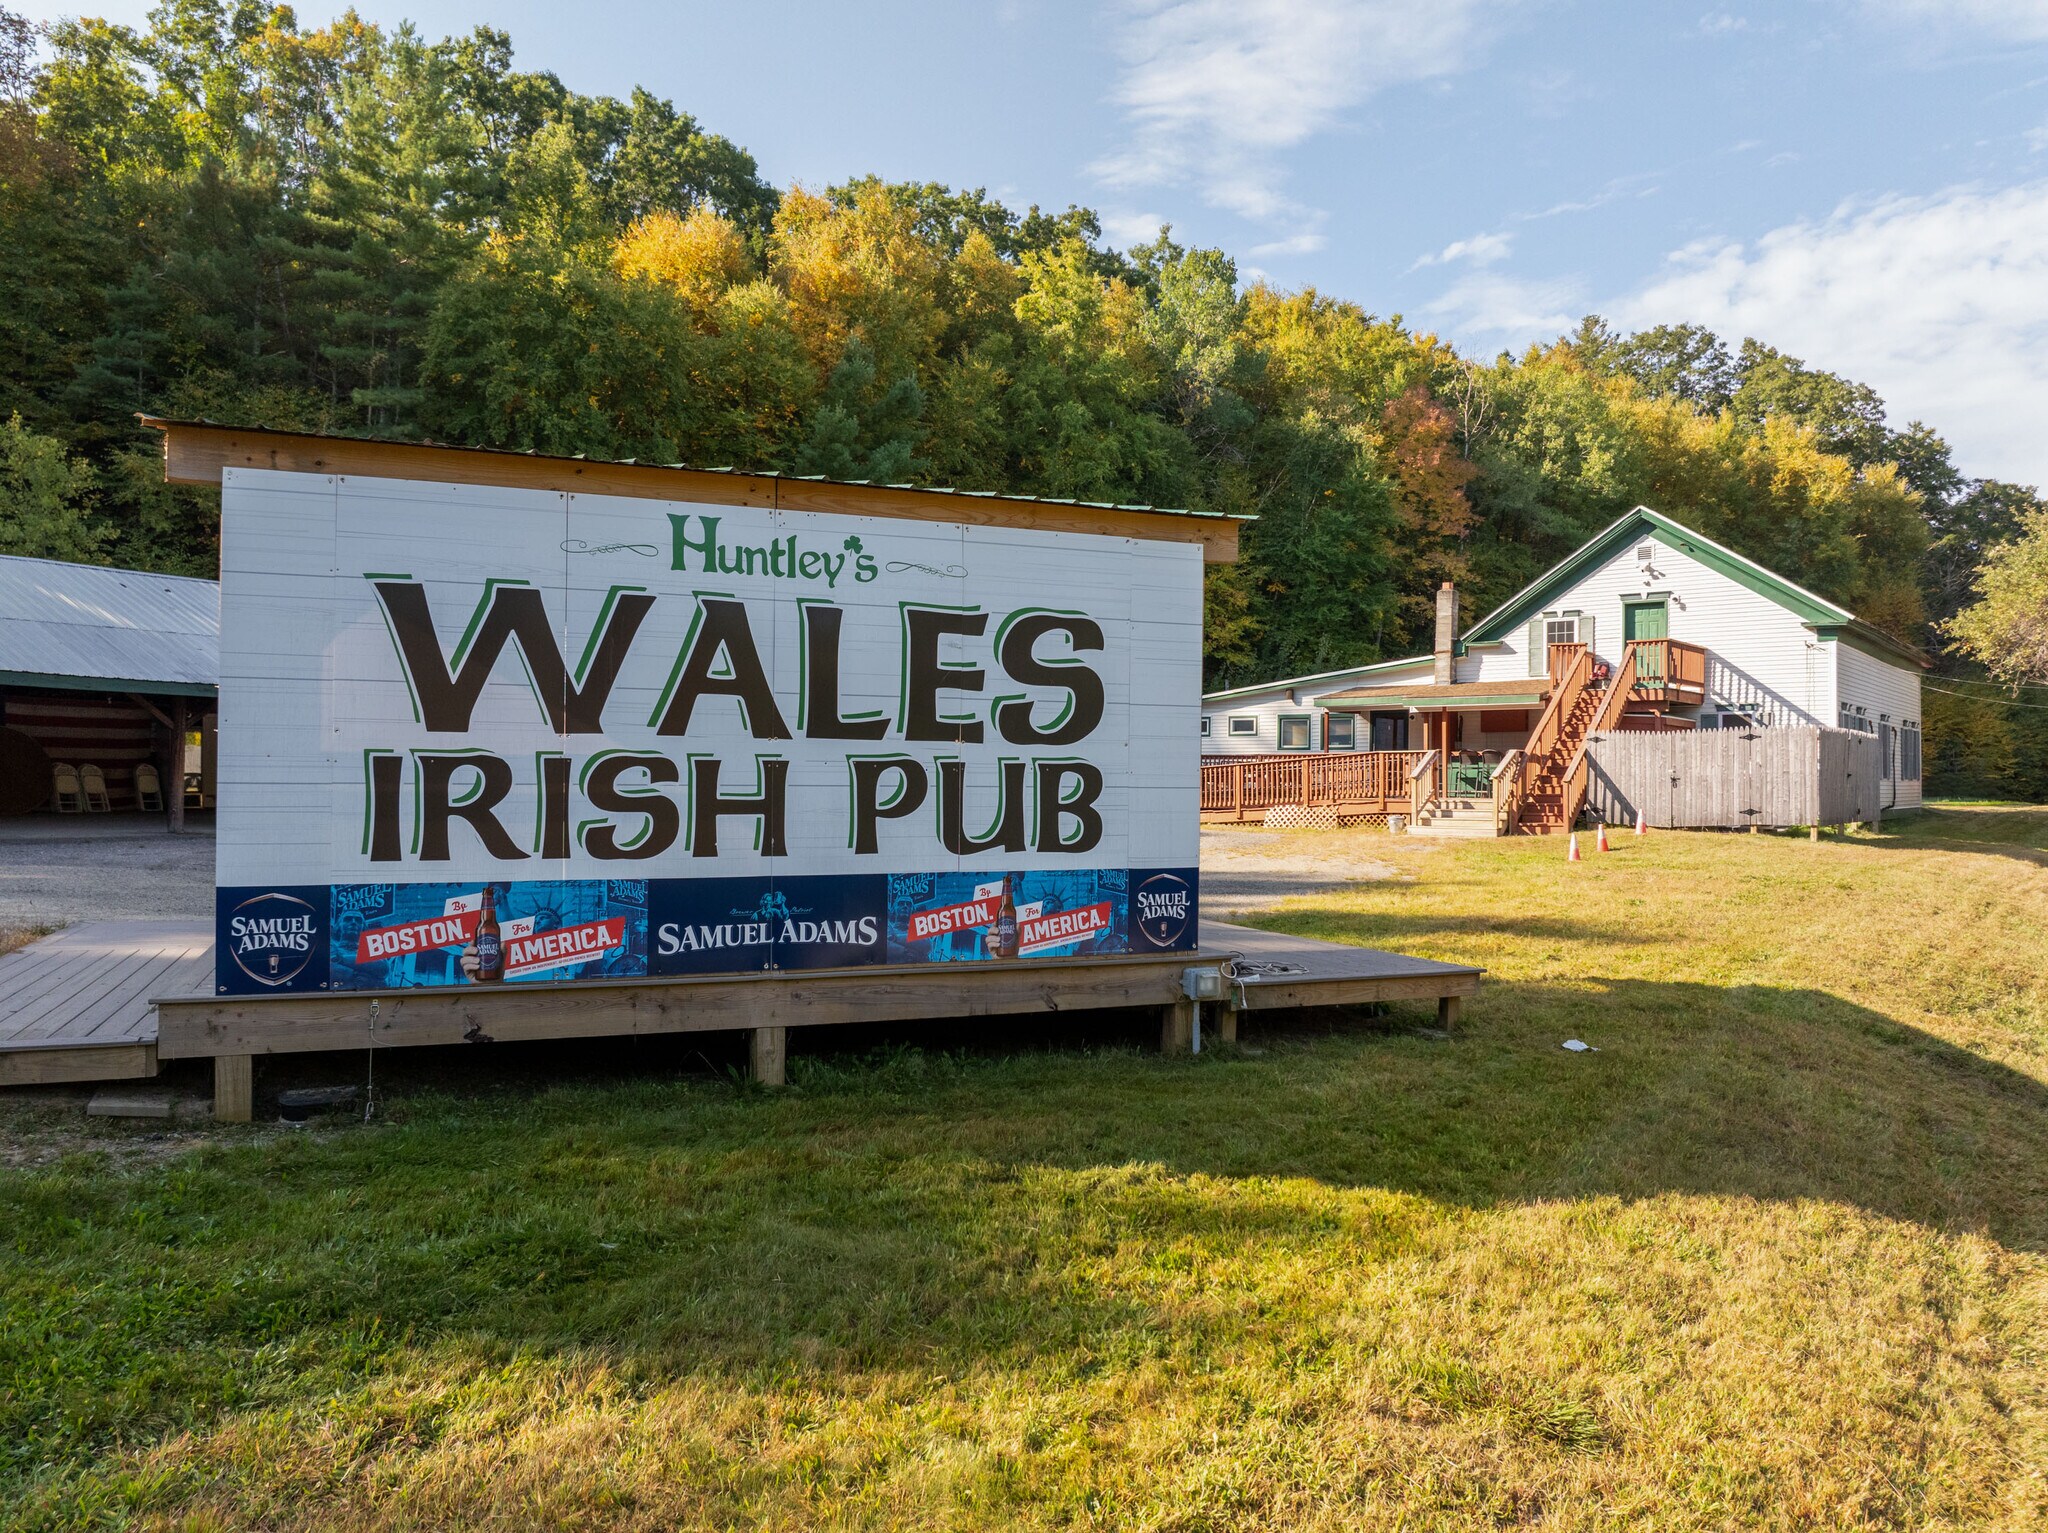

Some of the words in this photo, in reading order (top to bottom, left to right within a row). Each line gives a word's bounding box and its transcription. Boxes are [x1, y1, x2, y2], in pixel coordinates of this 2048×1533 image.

[363, 573, 1104, 745] WALES
[362, 748, 788, 861] IRISH
[845, 753, 1103, 856] PUB
[980, 888, 991, 898] By
[1137, 890, 1190, 908] SAMUEL
[452, 901, 468, 912] By
[1025, 907, 1040, 918] For
[1142, 905, 1186, 922] ADAMS
[231, 915, 317, 937] SAMUEL
[512, 924, 531, 935] For
[914, 903, 994, 936] BOSTON.
[1023, 909, 1106, 944] AMERICA.
[237, 933, 310, 954] ADAMS
[366, 918, 471, 957] BOSTON.
[510, 925, 618, 966] AMERICA.
[658, 922, 774, 955] SAMUEL
[778, 916, 878, 945] ADAMS
